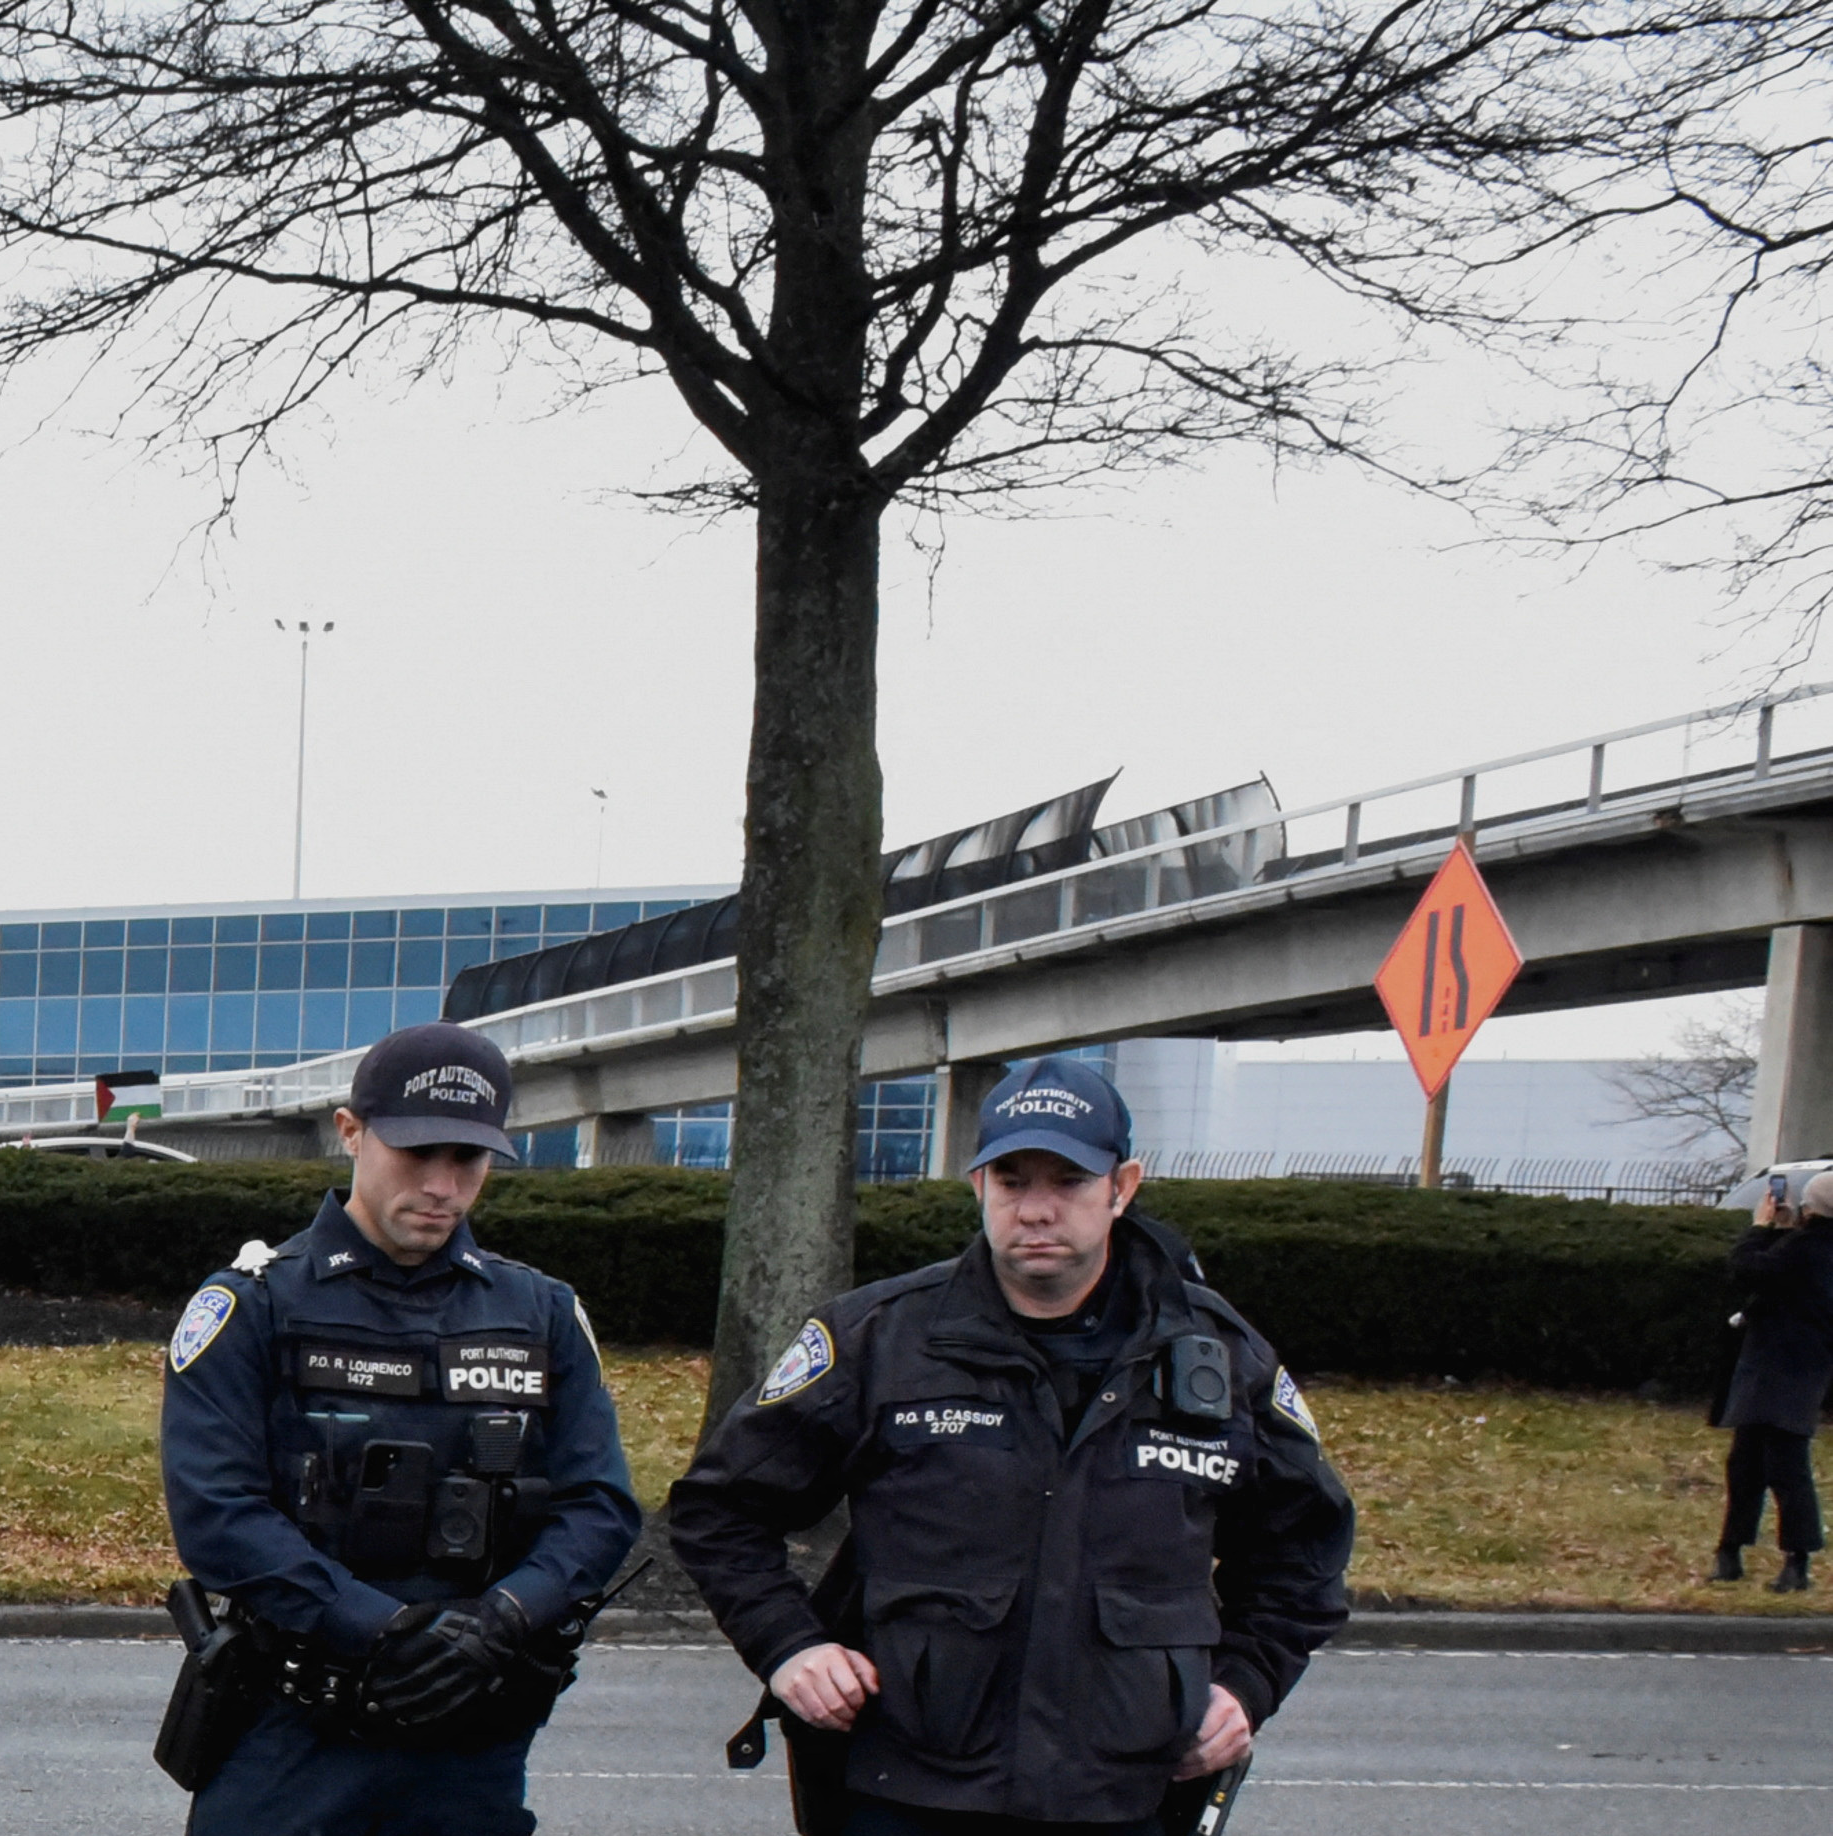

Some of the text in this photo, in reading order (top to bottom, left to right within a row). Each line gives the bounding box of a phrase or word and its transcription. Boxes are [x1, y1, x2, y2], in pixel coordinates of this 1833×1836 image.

[403, 1065, 496, 1107] PORT AUTHORITY
[429, 1087, 478, 1104] POLICE
[995, 1088, 1094, 1114] PORT AUTHORITY
[1009, 1100, 1077, 1119] POLICE
[328, 1252, 353, 1267] JFK
[462, 1252, 482, 1270] JFK
[460, 1347, 530, 1363] PORT AUTHORITY
[348, 1360, 412, 1376] LOURENCO
[347, 1372, 374, 1386] 1472
[449, 1367, 543, 1394] POLICE
[942, 1409, 1004, 1427] CASSIDY
[930, 1421, 967, 1434] 2707
[1149, 1429, 1228, 1451] PORT AUTHORITY
[1136, 1445, 1240, 1486] POLICE
